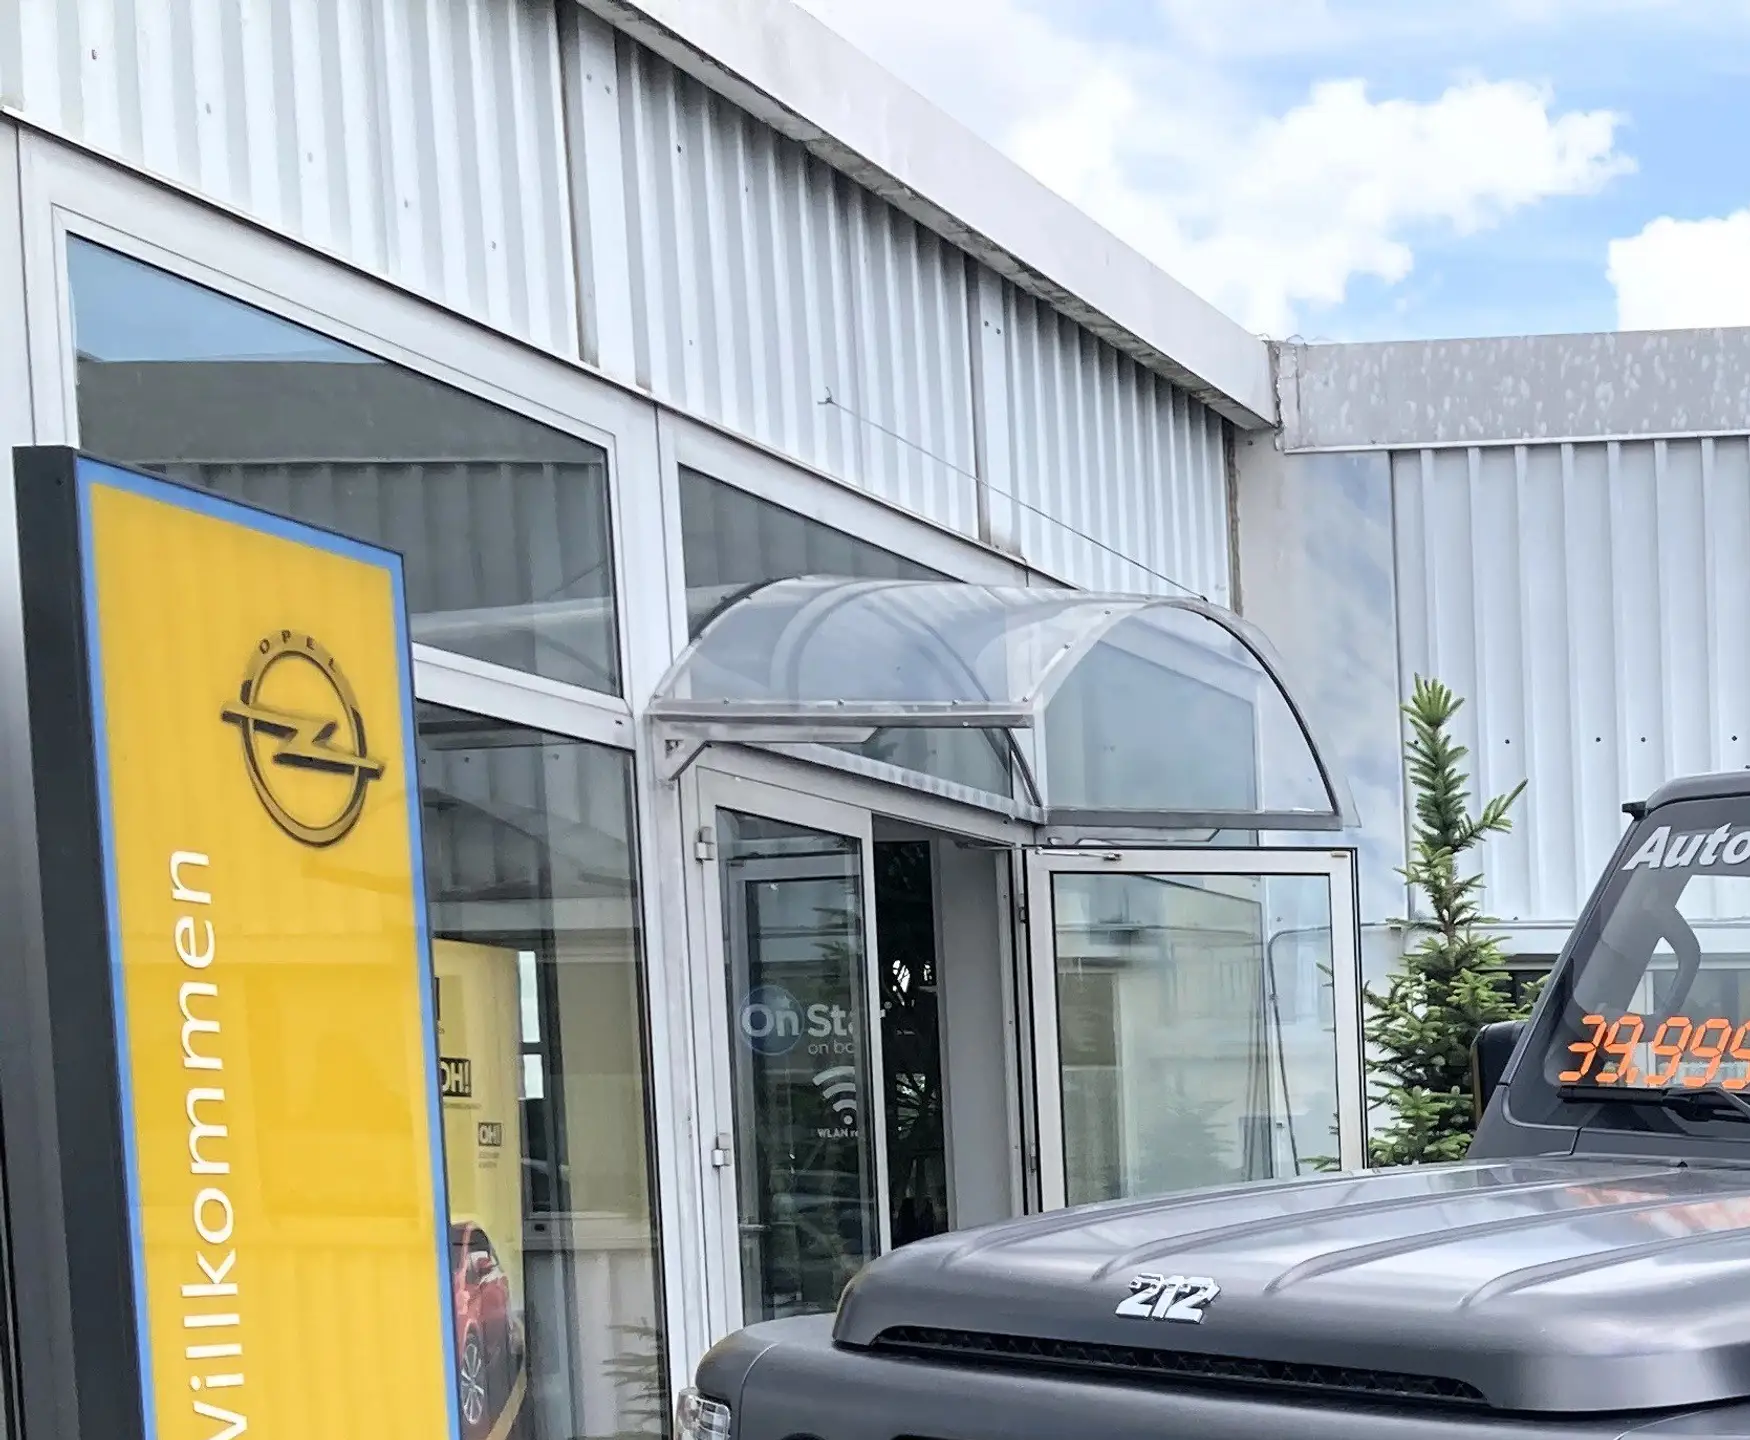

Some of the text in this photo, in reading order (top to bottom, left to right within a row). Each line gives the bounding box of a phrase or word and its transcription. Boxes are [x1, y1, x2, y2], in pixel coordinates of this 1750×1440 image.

[259, 630, 336, 673] OPEL
[817, 1127, 848, 1138] WLAN
[1115, 1272, 1220, 1324] 212
